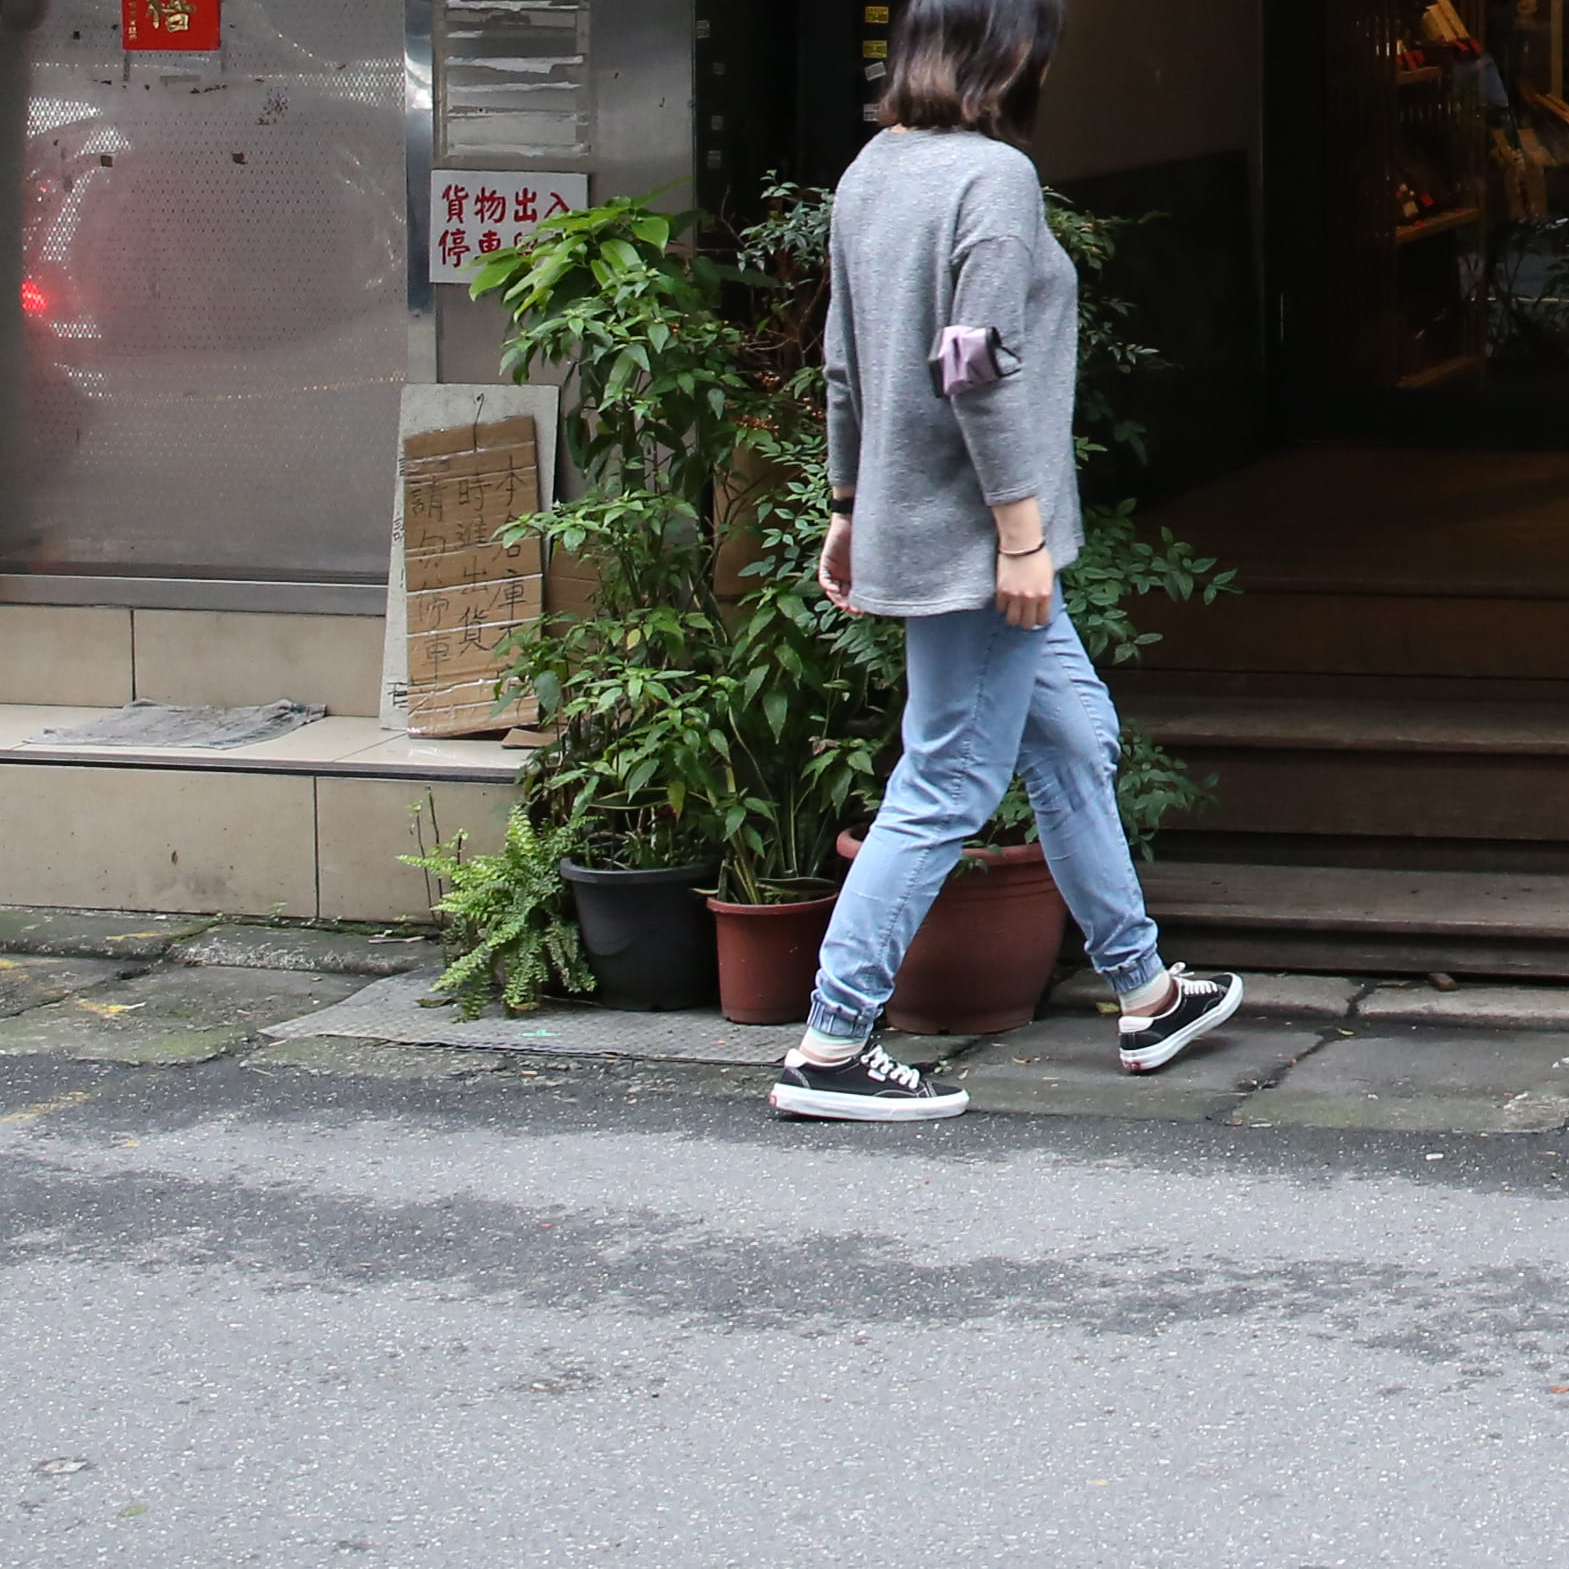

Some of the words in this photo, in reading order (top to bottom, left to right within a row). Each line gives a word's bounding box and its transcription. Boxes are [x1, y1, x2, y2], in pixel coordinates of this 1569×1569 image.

[442, 184, 571, 224] 貨物出入
[439, 228, 564, 268] 停車
[456, 471, 492, 658] 時進出貨
